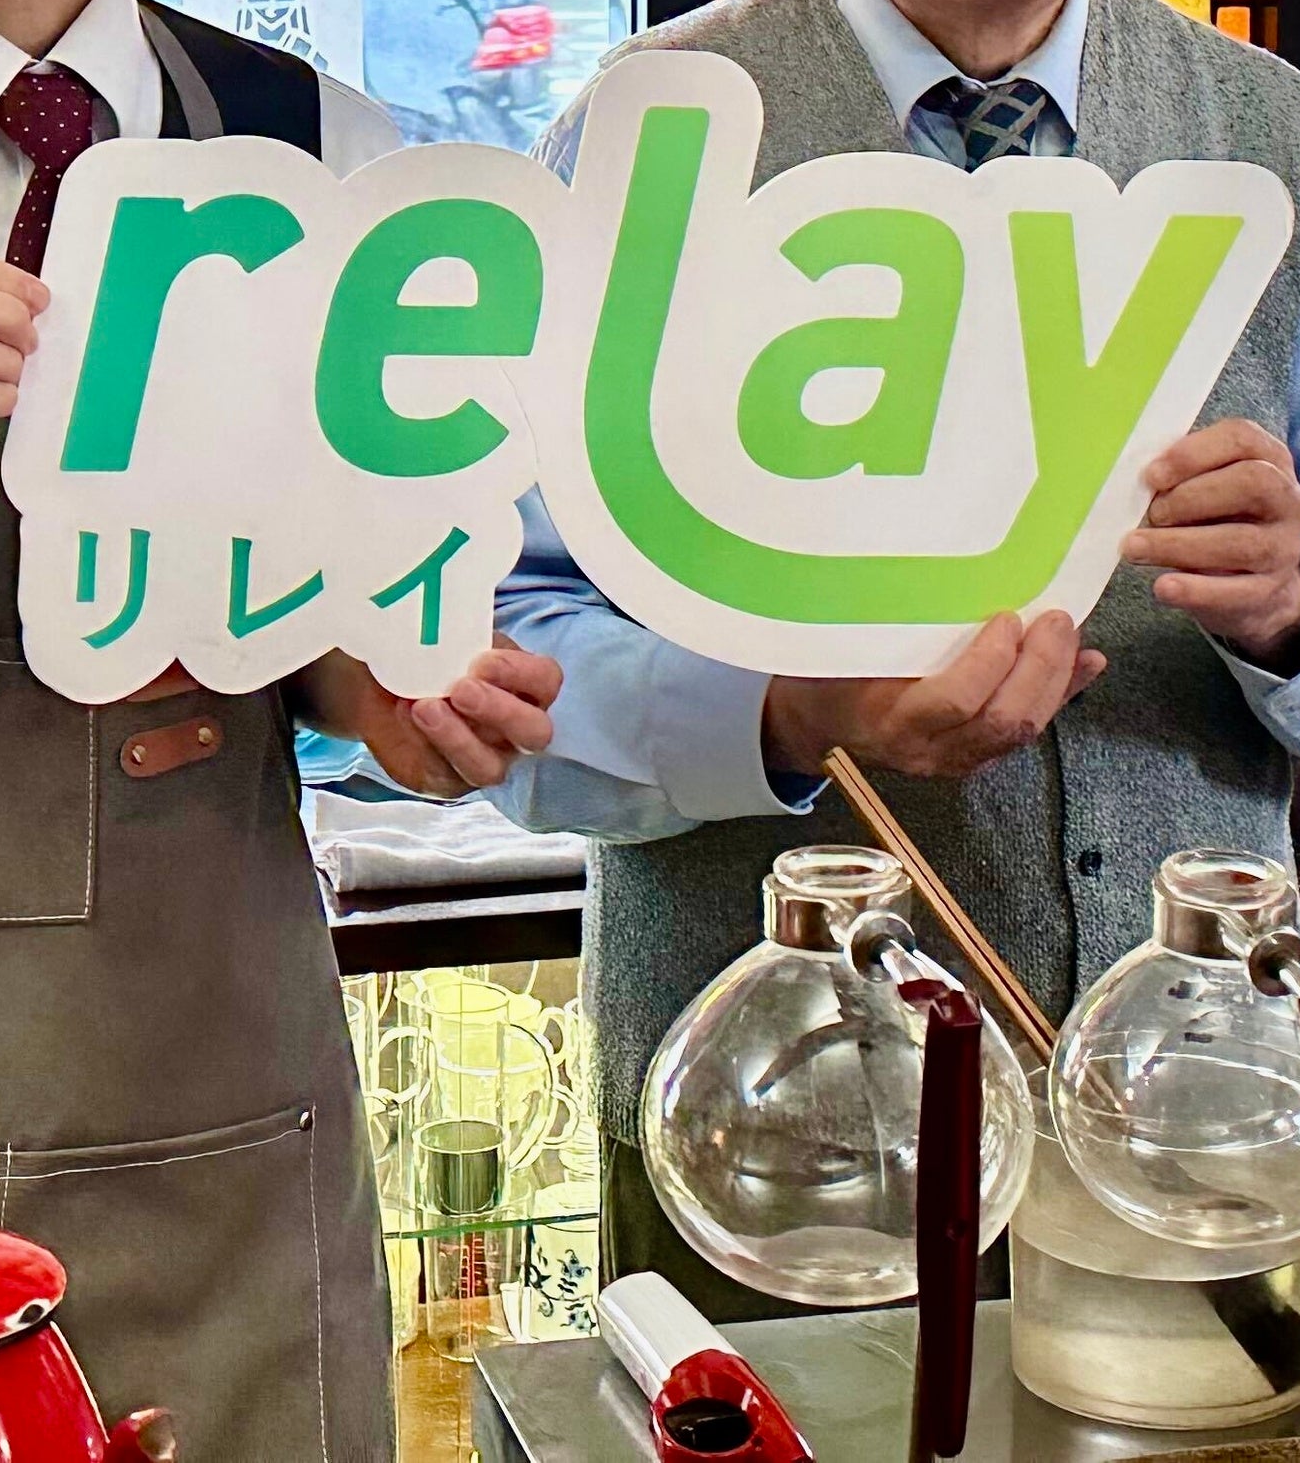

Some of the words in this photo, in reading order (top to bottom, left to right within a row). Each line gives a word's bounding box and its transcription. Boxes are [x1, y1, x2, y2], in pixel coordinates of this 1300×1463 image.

[60, 106, 1244, 625] relay
[76, 527, 470, 650] リレイ
